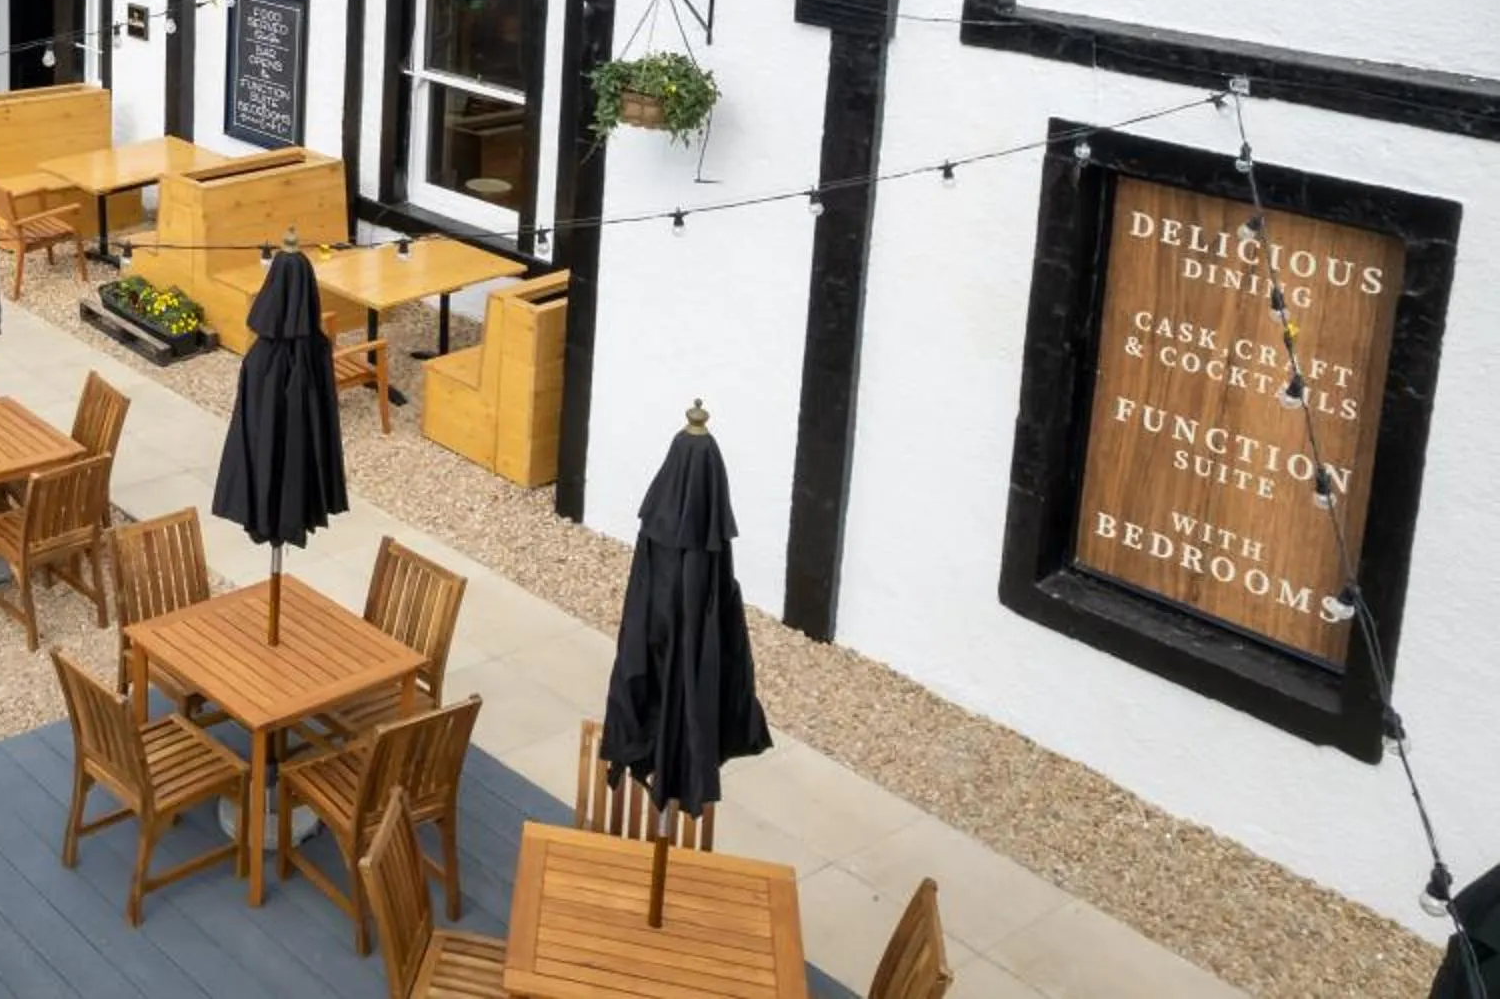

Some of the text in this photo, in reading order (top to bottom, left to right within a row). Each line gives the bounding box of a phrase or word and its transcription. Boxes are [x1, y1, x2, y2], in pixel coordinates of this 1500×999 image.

[1130, 211, 1383, 295] DELICIOUS
[1135, 311, 1229, 358] CASK,
[1124, 336, 1358, 420] & COCKTILS
[1113, 396, 1353, 494] FUNCTION
[1173, 450, 1276, 499] SUITE
[1095, 512, 1341, 623] BEDROOMS
[1171, 511, 1265, 562] WITH
